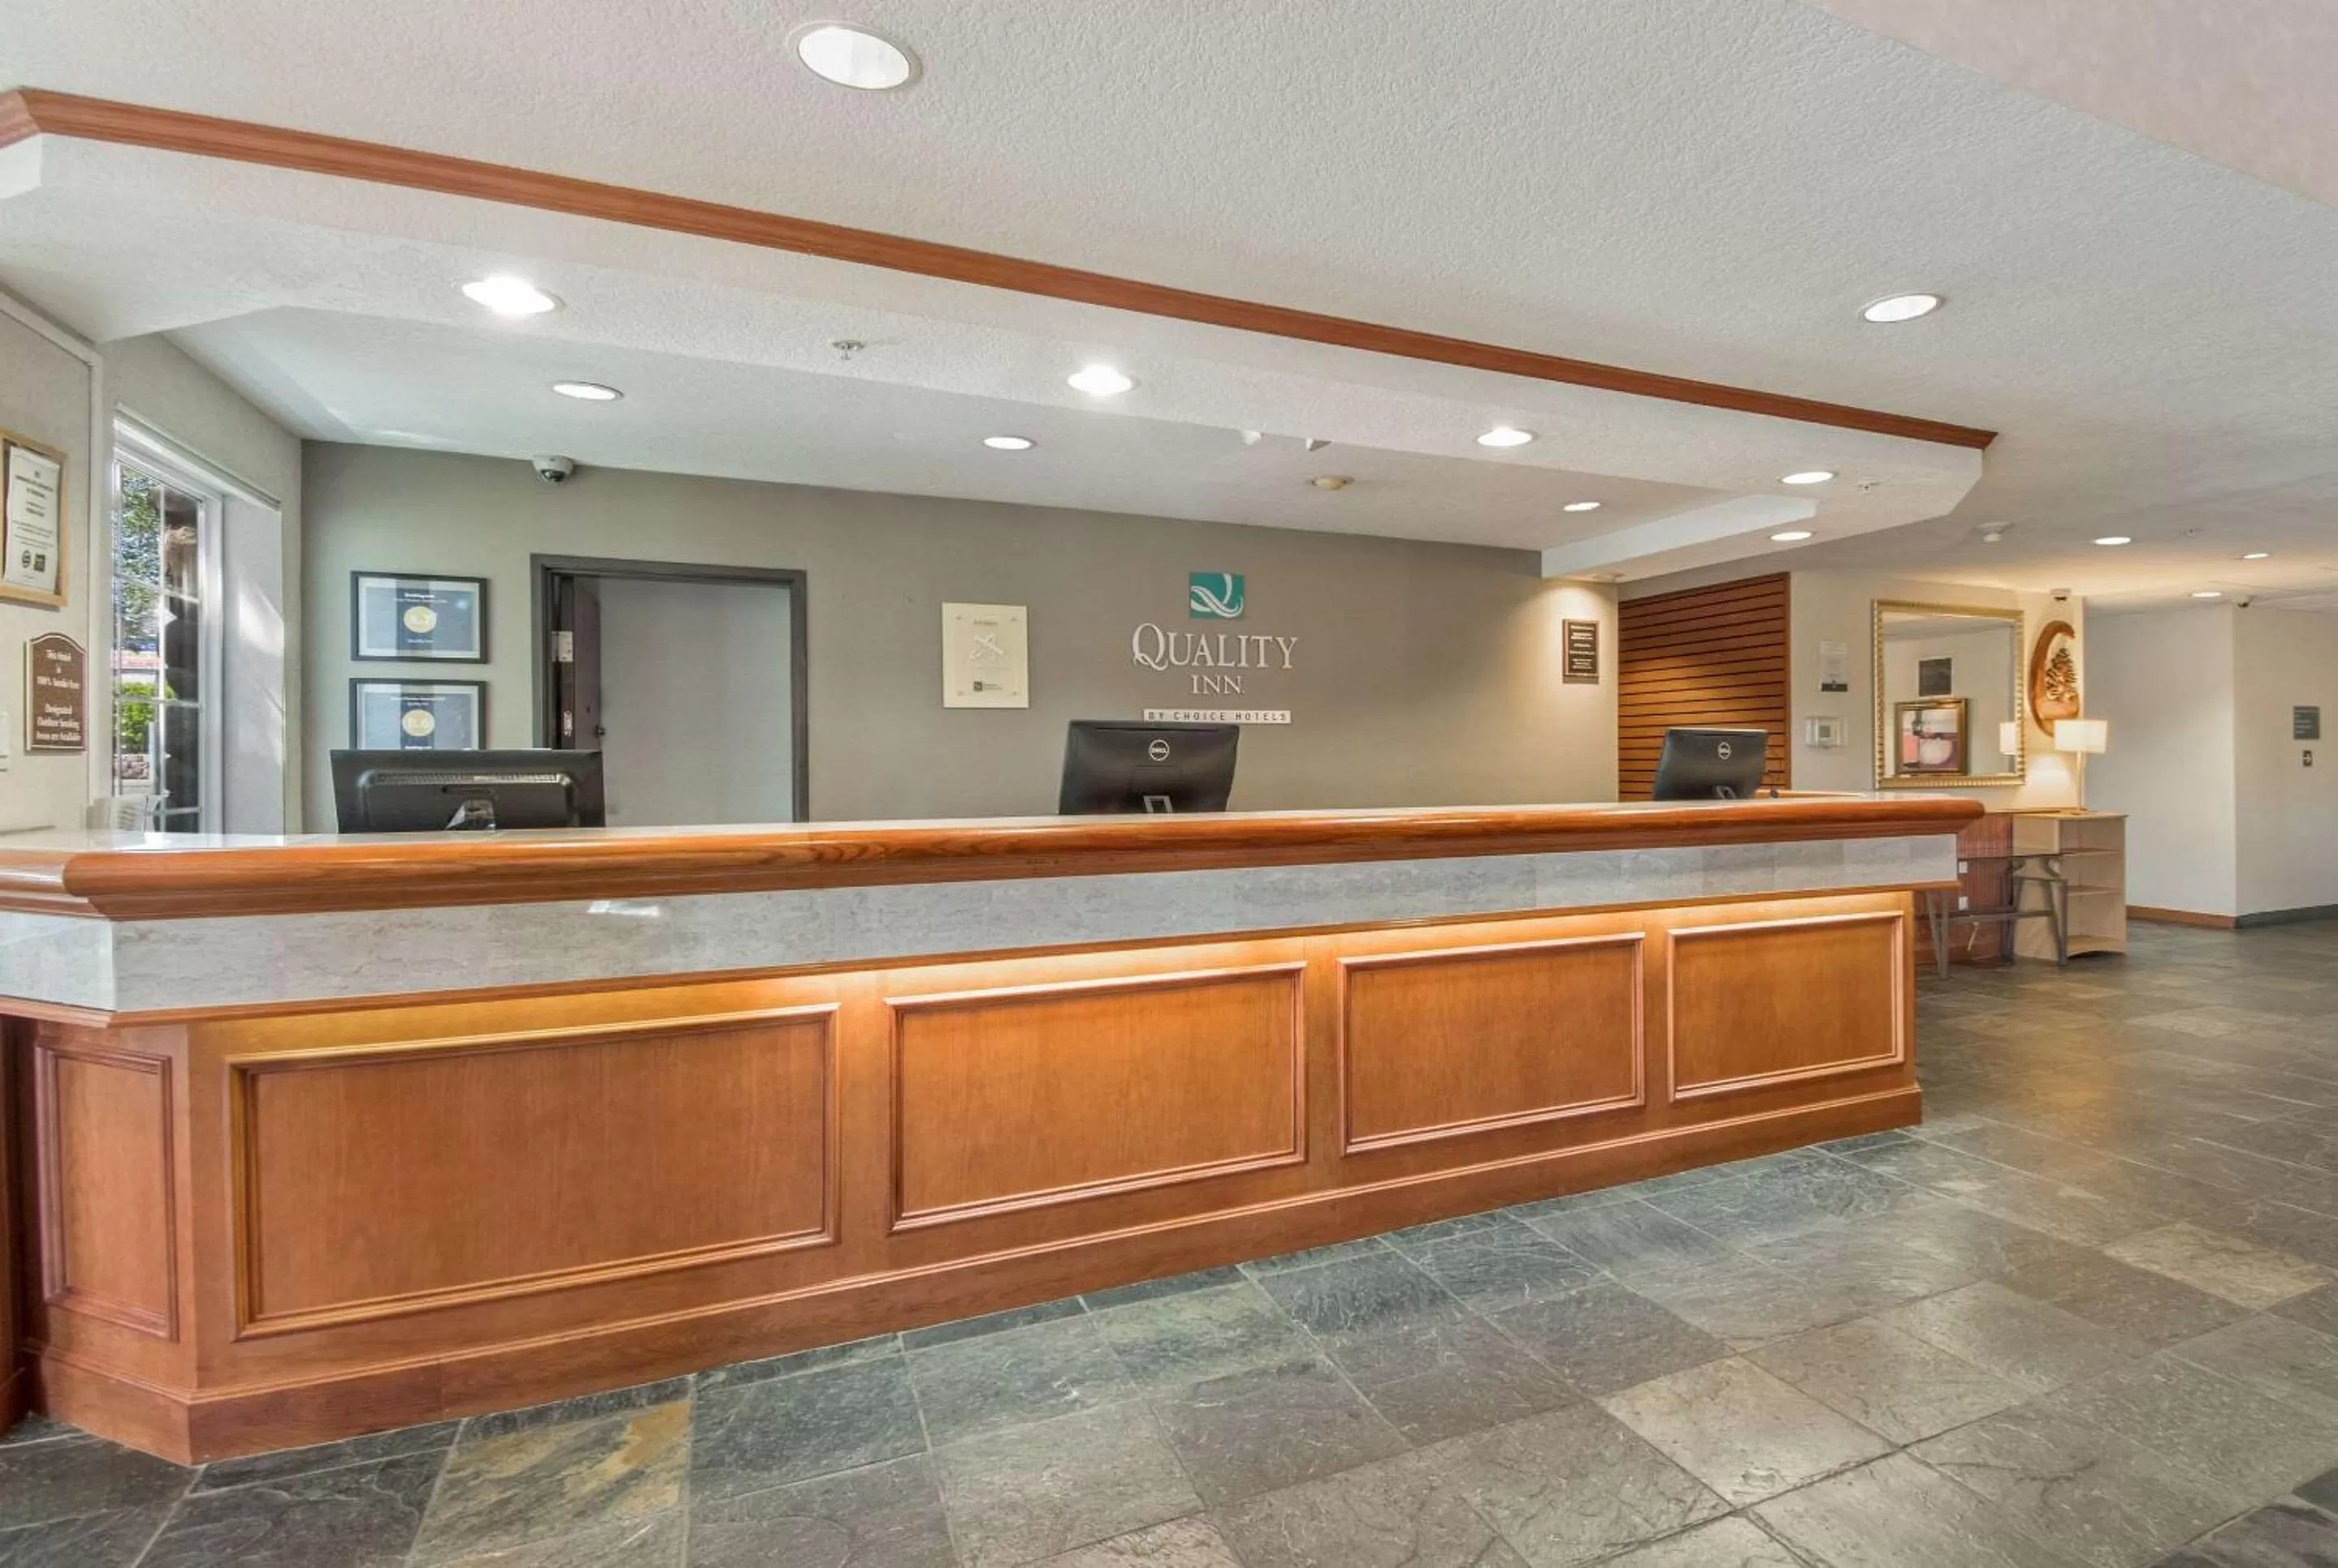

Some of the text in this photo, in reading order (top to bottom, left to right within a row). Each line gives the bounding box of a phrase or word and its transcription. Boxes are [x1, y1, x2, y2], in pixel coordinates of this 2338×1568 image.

[1132, 622, 1297, 670] QUALITY
[1191, 674, 1241, 695] INN
[1148, 712, 1287, 722] BY CHOICE HOTELS
